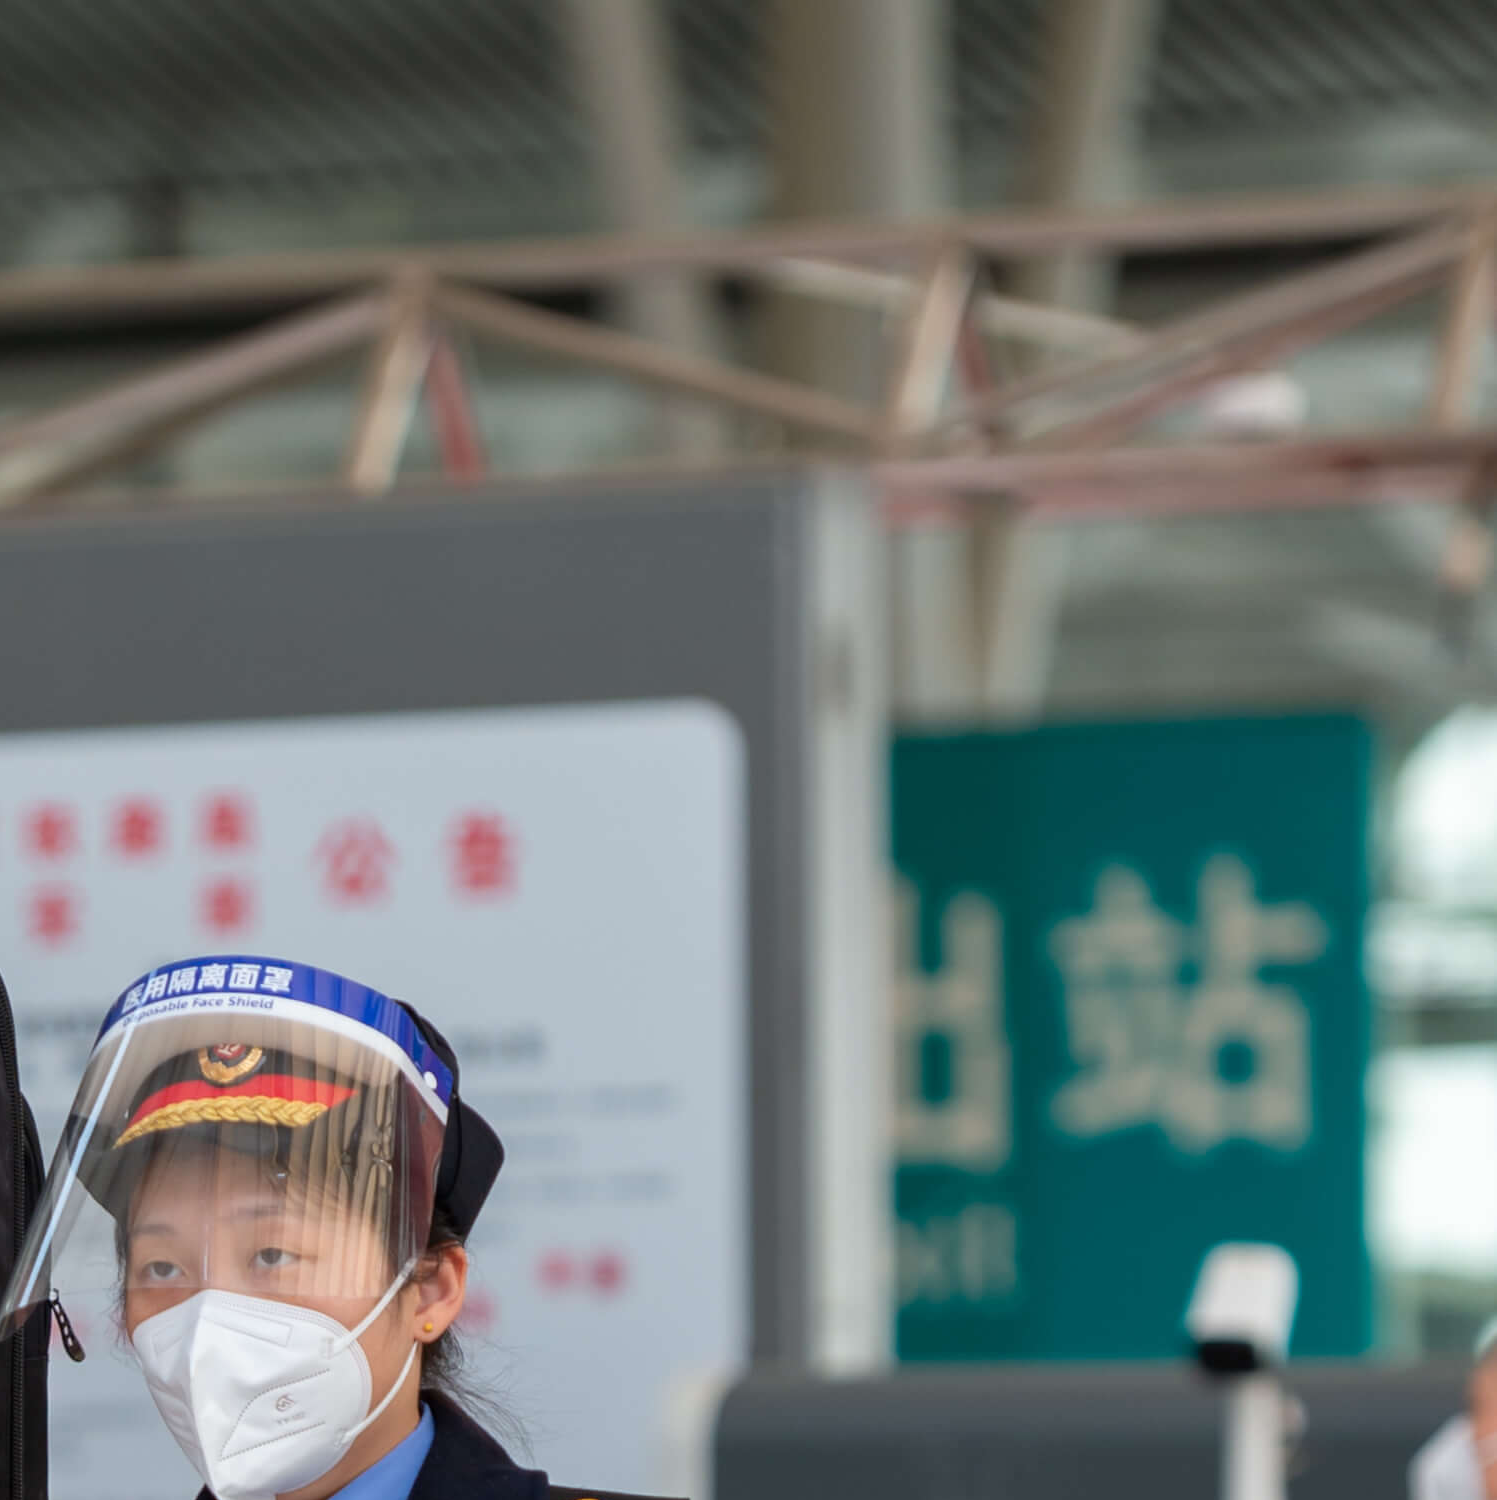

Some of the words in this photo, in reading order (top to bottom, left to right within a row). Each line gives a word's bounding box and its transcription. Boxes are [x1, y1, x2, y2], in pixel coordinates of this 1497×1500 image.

[121, 962, 293, 1014] 医用隔离面罩
[122, 1000, 189, 1026] Dposable
[192, 996, 223, 1008] Face
[228, 995, 274, 1009] Shield
